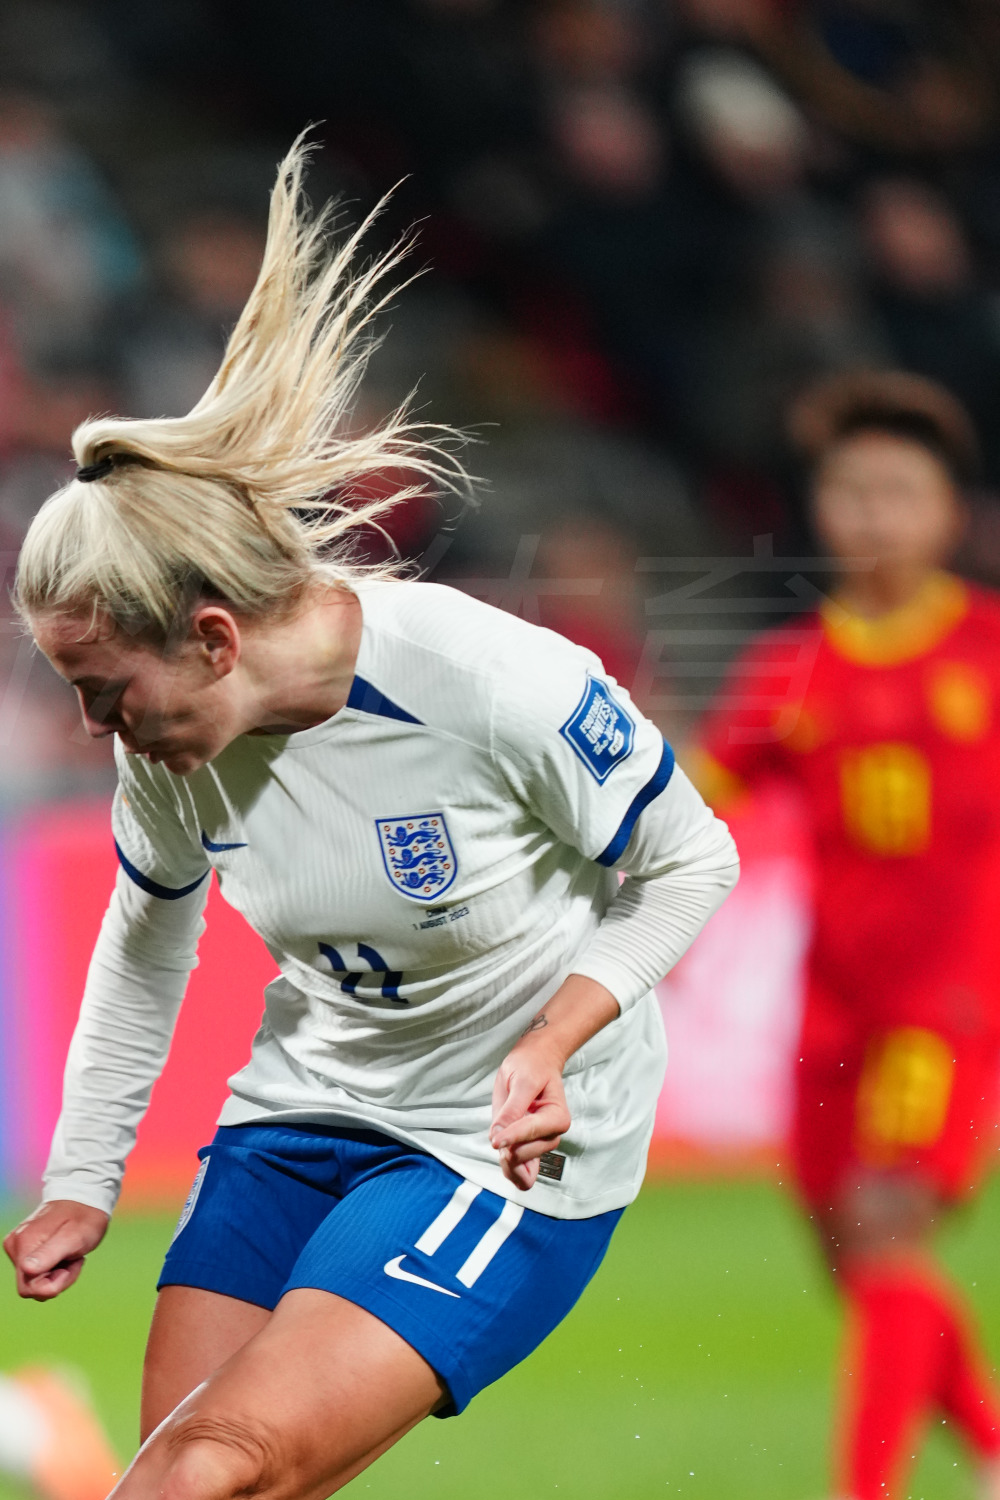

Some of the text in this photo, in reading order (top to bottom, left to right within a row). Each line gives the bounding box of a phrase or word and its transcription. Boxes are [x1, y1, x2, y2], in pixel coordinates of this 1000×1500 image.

[585, 703, 611, 744] UNITES
[449, 907, 470, 921] 2023
[317, 942, 409, 1004] 11
[414, 1179, 524, 1288] 11
